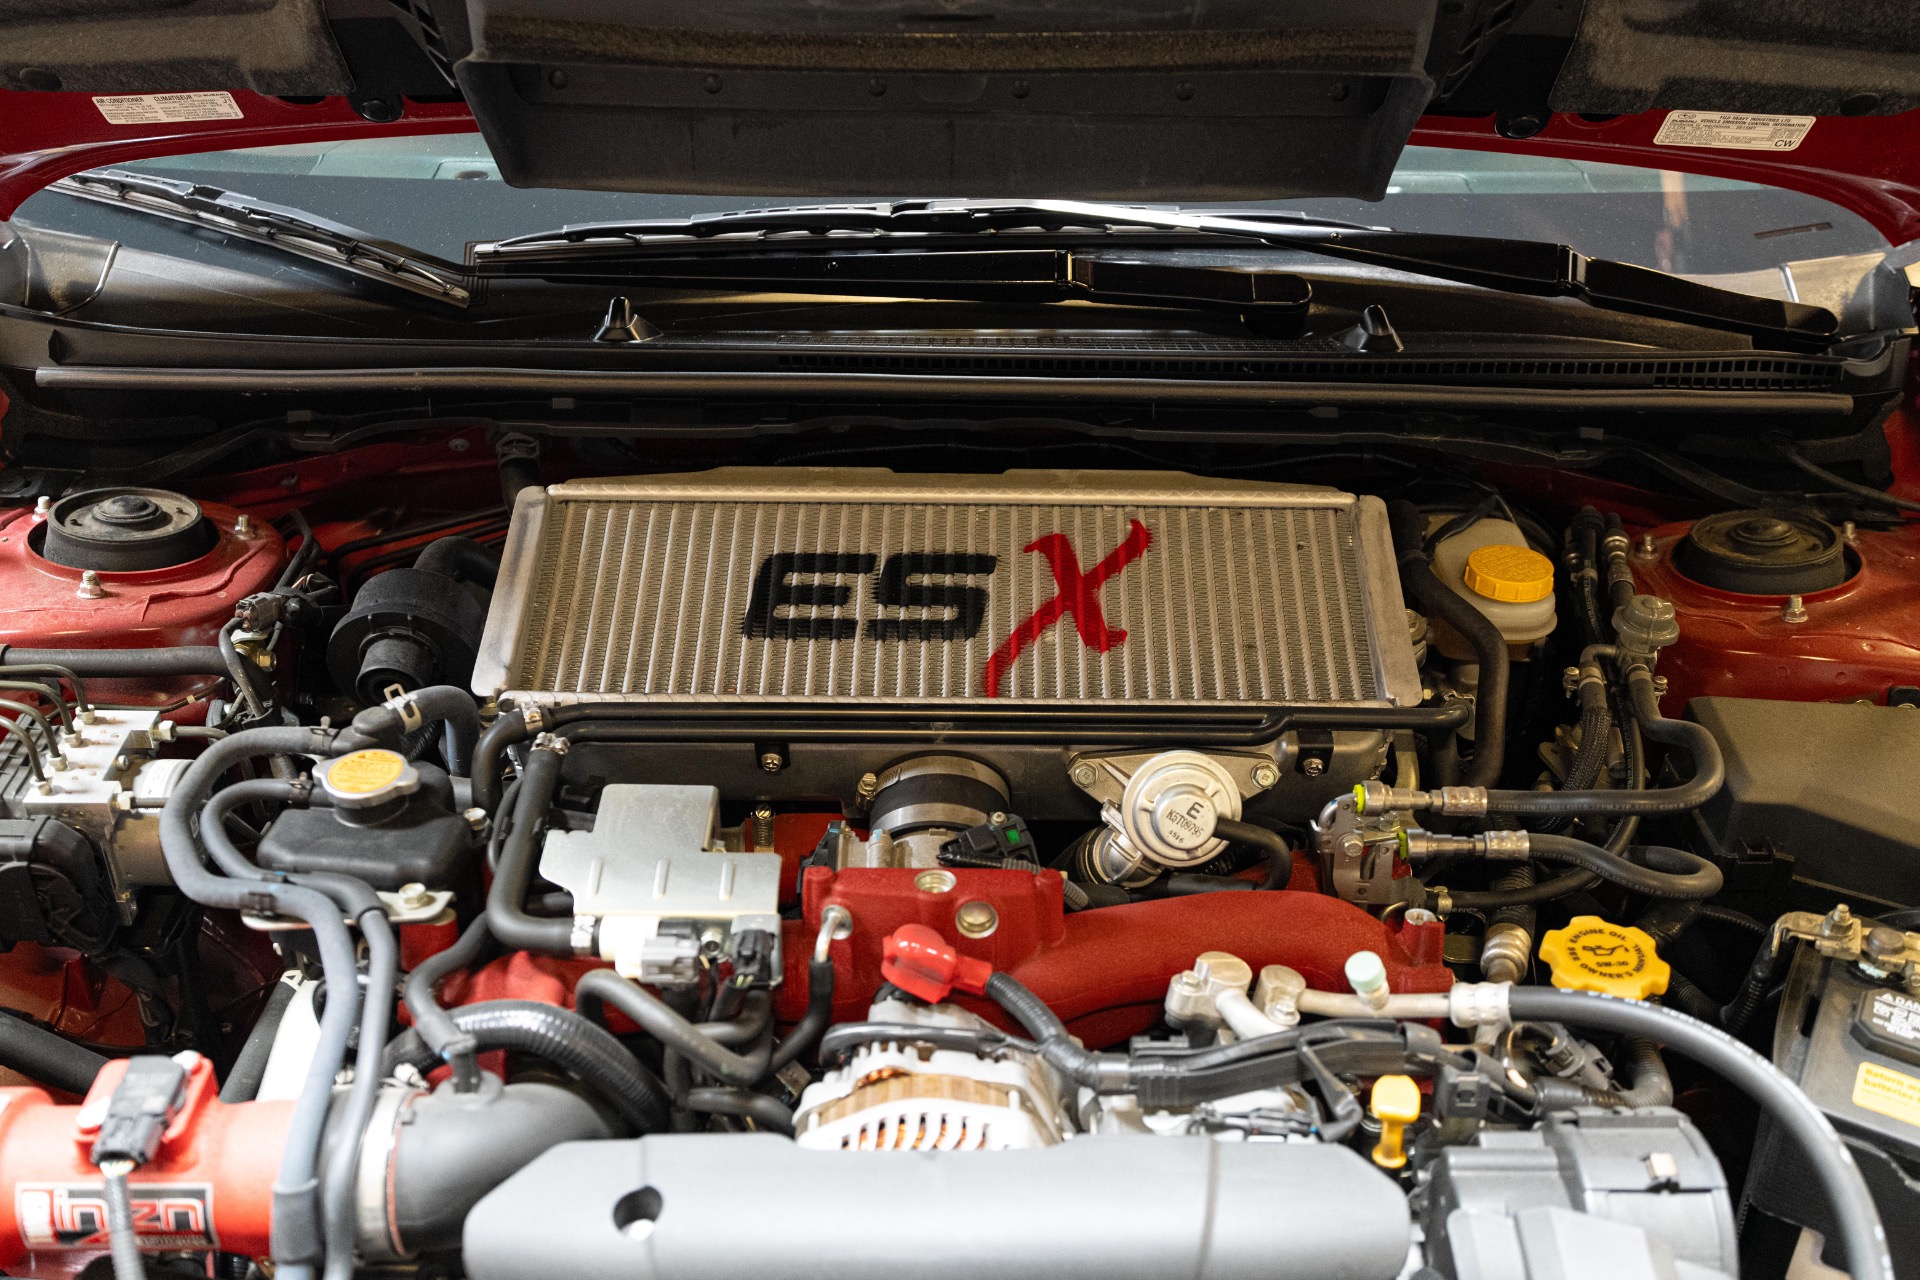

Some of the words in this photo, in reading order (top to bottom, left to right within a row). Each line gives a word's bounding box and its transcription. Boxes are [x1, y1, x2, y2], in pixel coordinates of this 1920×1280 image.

[1774, 139, 1796, 148] CW
[1186, 801, 1204, 820] E
[1166, 809, 1204, 838] K5T09795
[1569, 928, 1605, 944] ENGINE
[1608, 931, 1627, 942] OIL
[1567, 946, 1581, 962] SEE
[1632, 943, 1646, 974] MANUAL
[1865, 1068, 1905, 1087] Return
[1863, 1077, 1914, 1102] batteries
